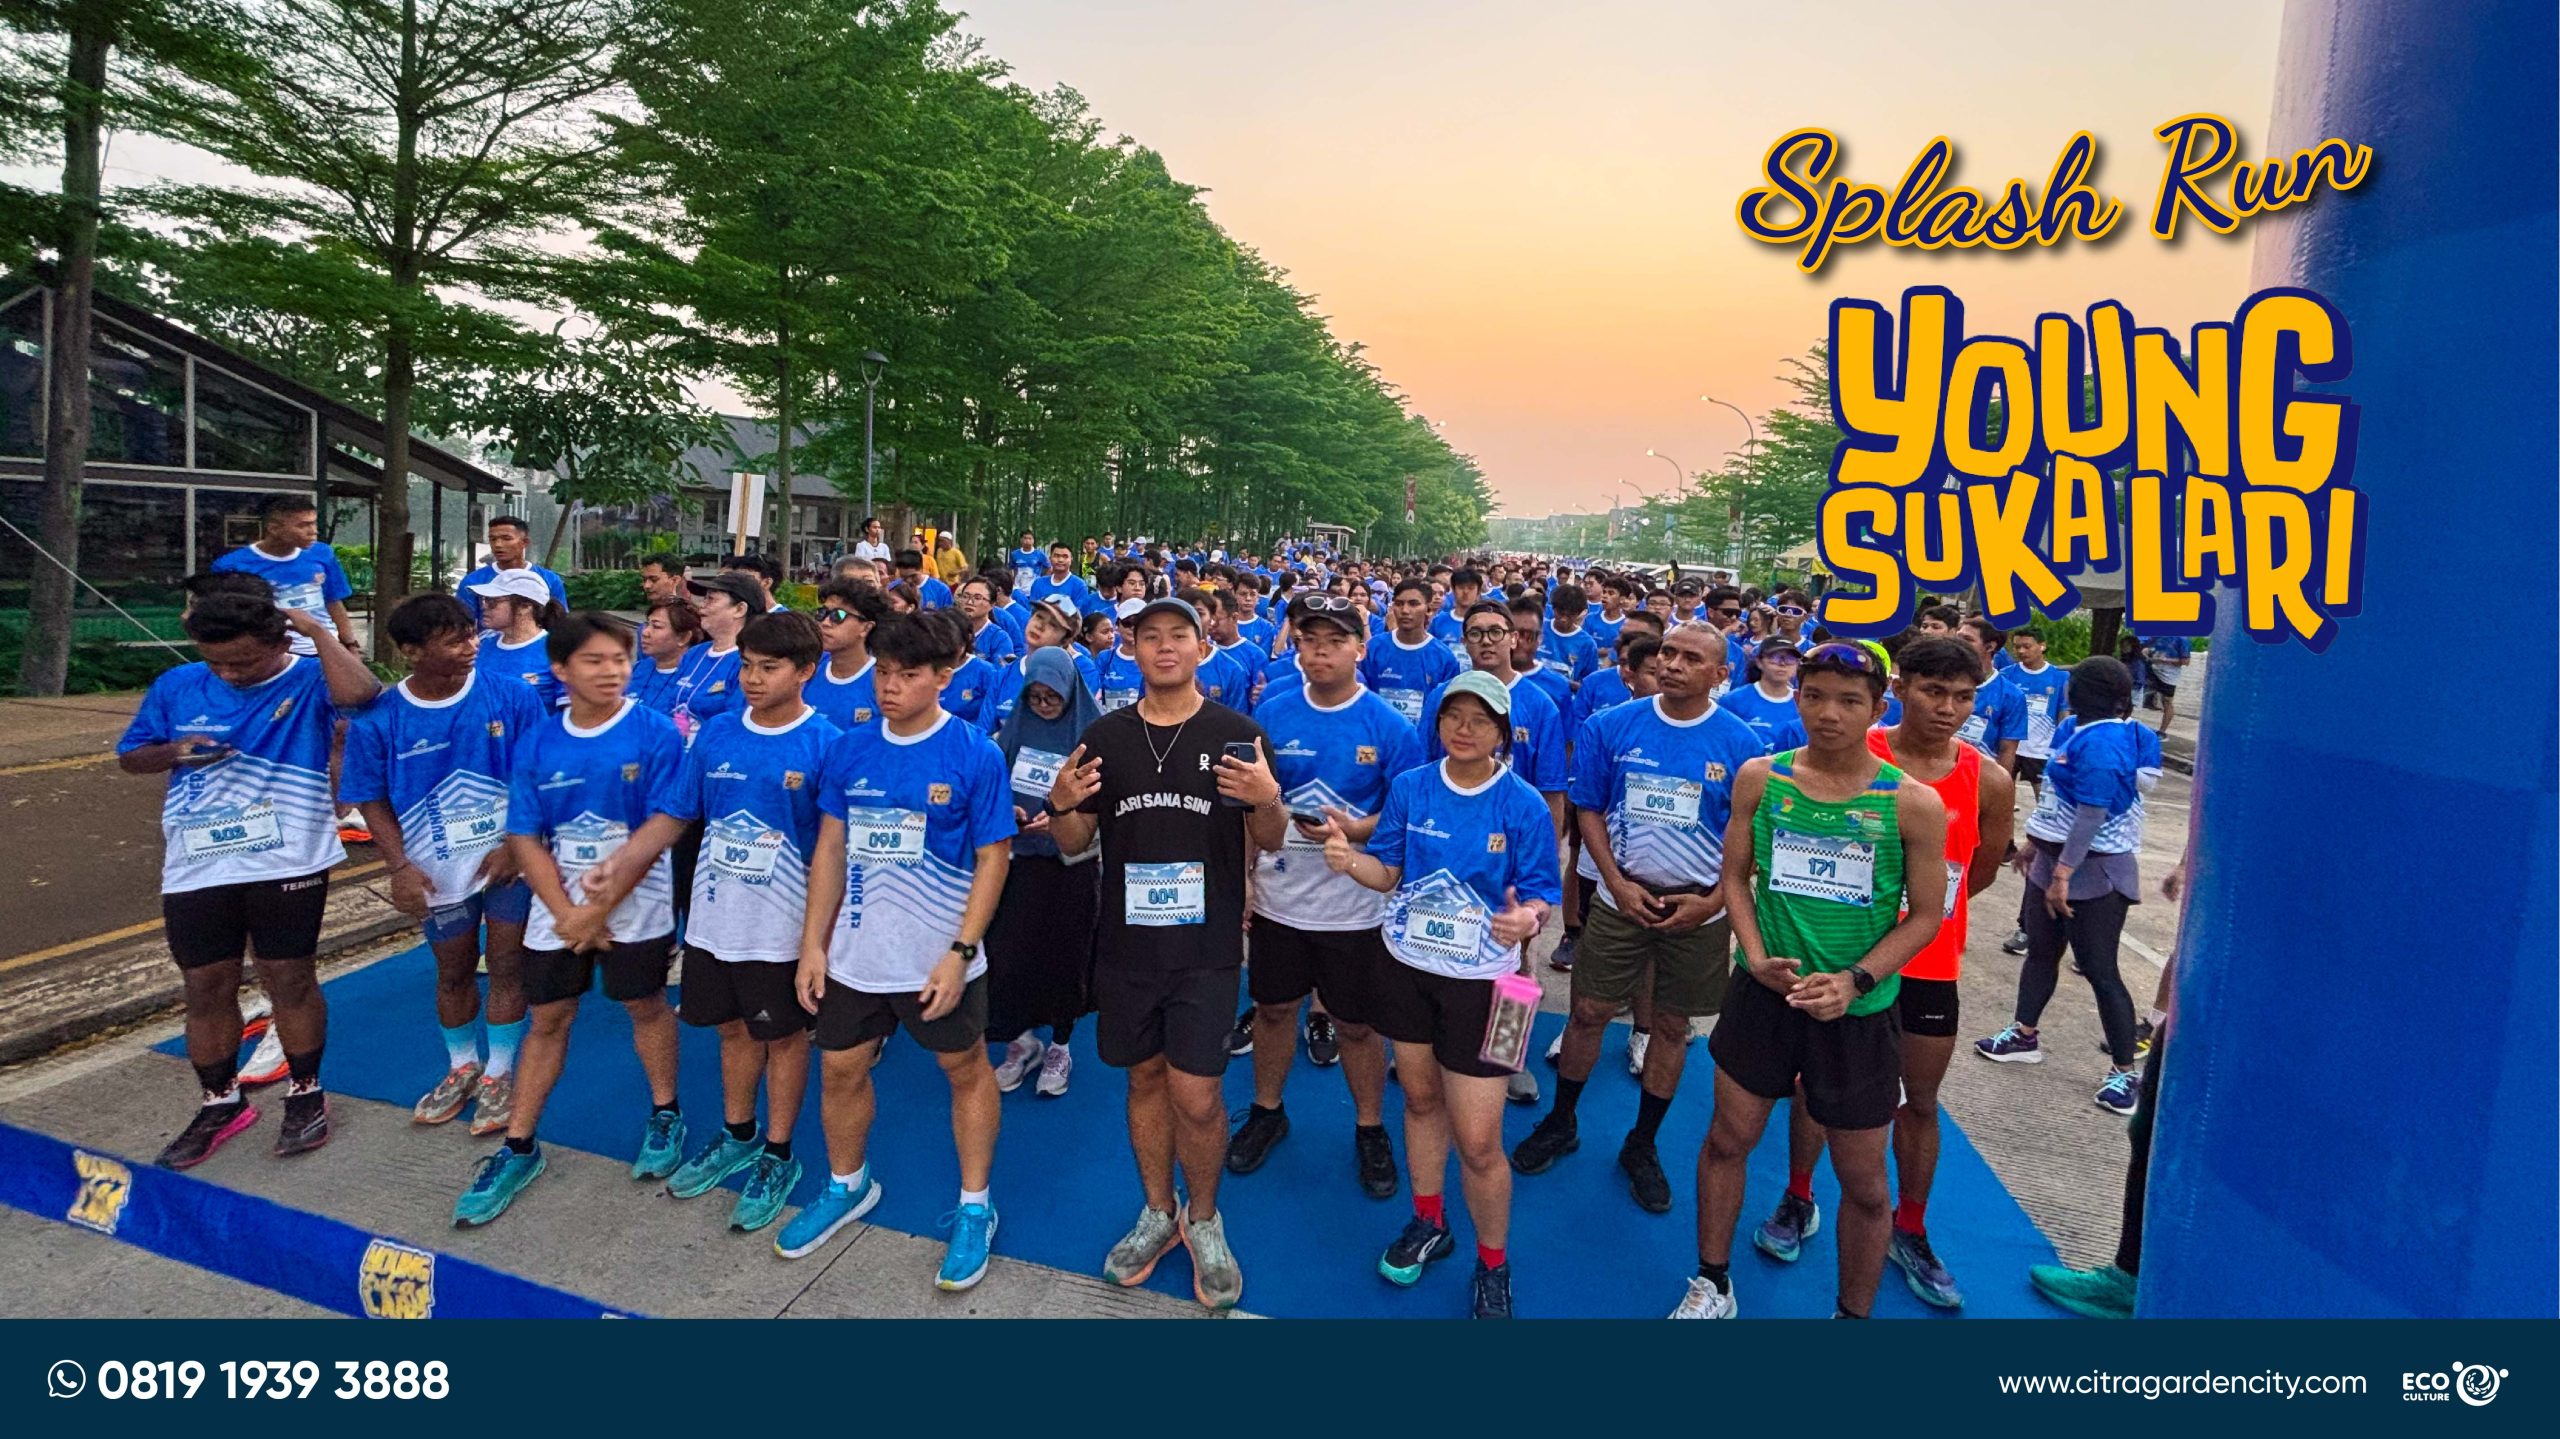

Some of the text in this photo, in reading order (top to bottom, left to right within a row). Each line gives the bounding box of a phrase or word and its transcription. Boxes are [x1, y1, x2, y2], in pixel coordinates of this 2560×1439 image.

[1142, 792, 1182, 808] SANA
[1183, 795, 1212, 815] SINI
[1808, 857, 1837, 879] 171
[1147, 887, 1179, 905] 004
[1425, 919, 1455, 940] 005
